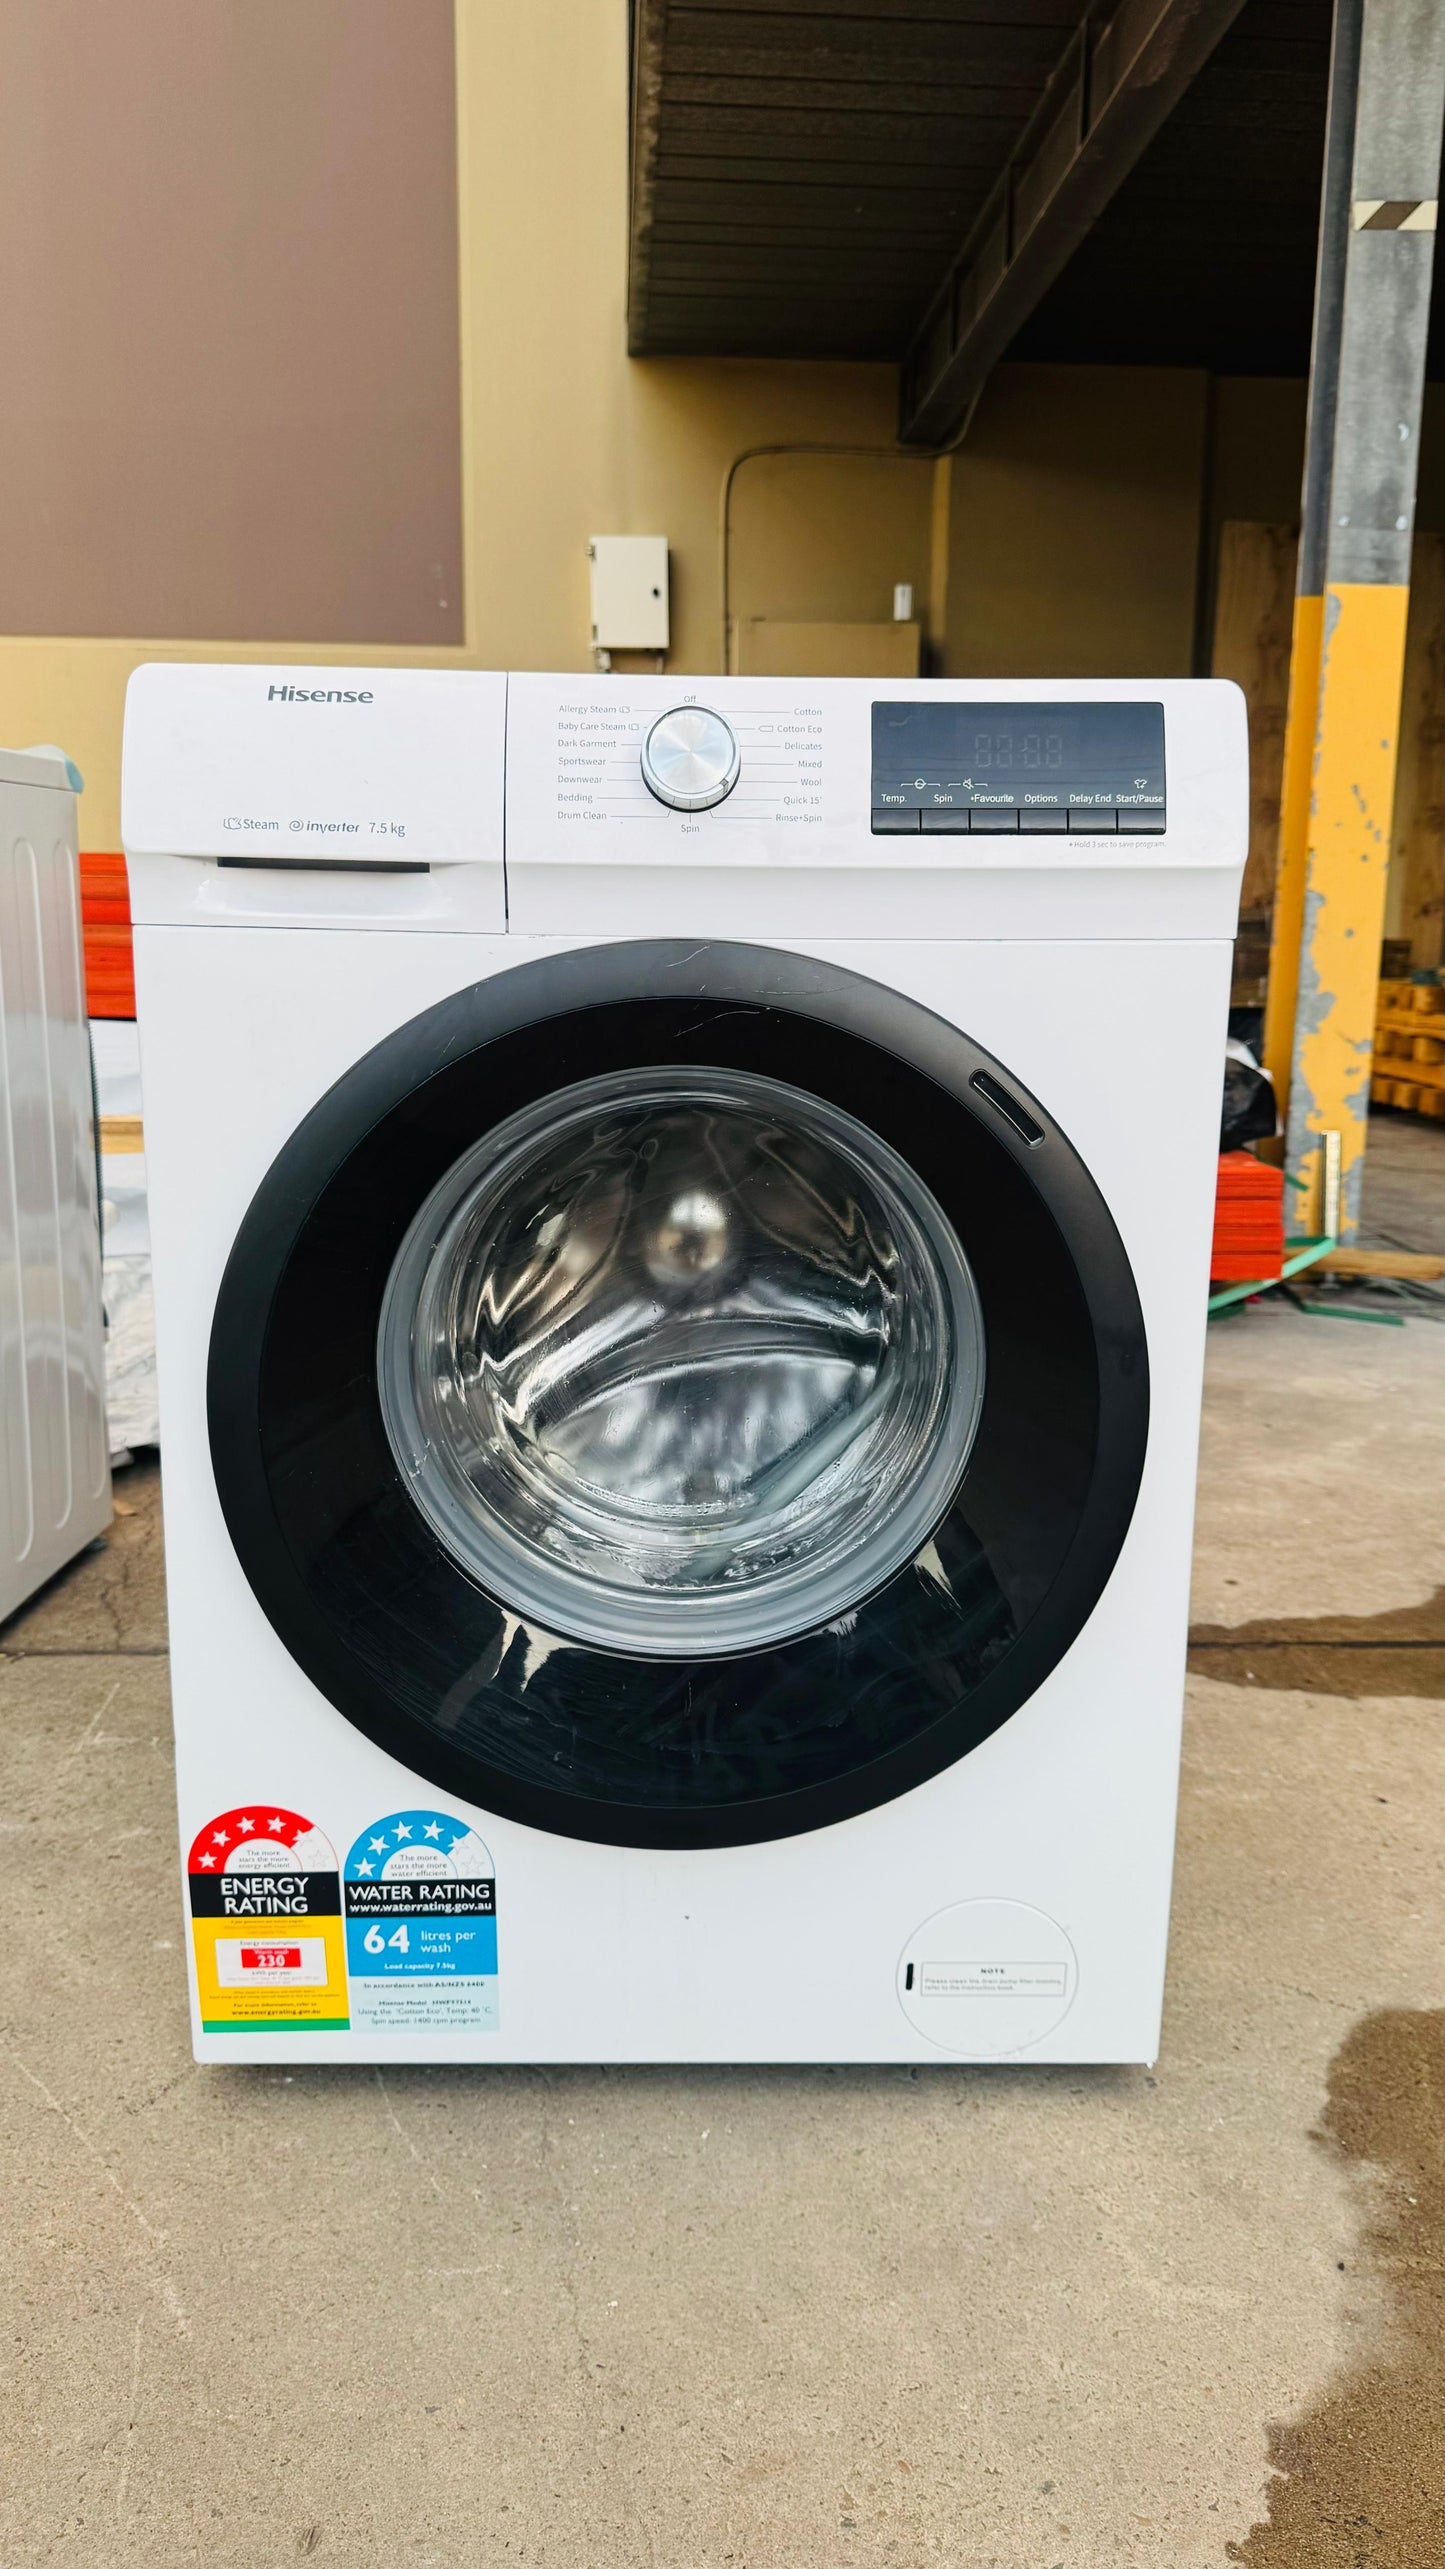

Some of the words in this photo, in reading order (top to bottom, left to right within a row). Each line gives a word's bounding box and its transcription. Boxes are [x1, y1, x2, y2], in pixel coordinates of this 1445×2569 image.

[267, 685, 374, 704] Hisense
[683, 695, 697, 703] Off
[558, 705, 589, 714] Allergy
[590, 705, 617, 713] Steam
[793, 708, 823, 716] Cotton
[557, 722, 579, 731] Baby
[580, 722, 599, 731] Care
[600, 723, 626, 731] Steam
[777, 725, 806, 733] Cotton
[807, 725, 823, 733] Eco
[557, 739, 578, 748] Dark
[580, 740, 617, 748] Garment
[784, 742, 823, 751] Delicates
[557, 757, 607, 766] Sportswear
[798, 760, 823, 768] Mixed
[557, 775, 603, 784] Downwear
[800, 778, 822, 786] Wool
[557, 793, 593, 804] Bedding
[783, 796, 808, 806] Quick
[881, 793, 908, 804] Temp.
[933, 793, 953, 804] Spin
[1024, 794, 1059, 804] Options
[1069, 794, 1094, 804] Delay
[1095, 793, 1112, 803] End
[1115, 794, 1164, 804] Start/Pause
[557, 811, 581, 819] Drum
[582, 811, 607, 820] Clean
[775, 813, 823, 823] Rinse+Spin
[243, 819, 279, 831] Steam
[306, 820, 360, 834] inverter
[369, 822, 388, 834] 7.5
[390, 822, 406, 837] kg
[680, 824, 700, 834] Spin
[220, 1877, 309, 1896] ENERGY
[349, 1886, 413, 1901] WATER
[419, 1884, 490, 1900] RATING
[224, 1897, 309, 1915] RATING
[349, 1902, 493, 1914] www.waterrating.gov.au
[363, 1924, 410, 1954] 64
[421, 1930, 452, 1941] litres
[455, 1931, 477, 1943] per
[420, 1943, 452, 1954] wash
[257, 1955, 286, 1968] 230
[404, 1963, 434, 1971] capacity
